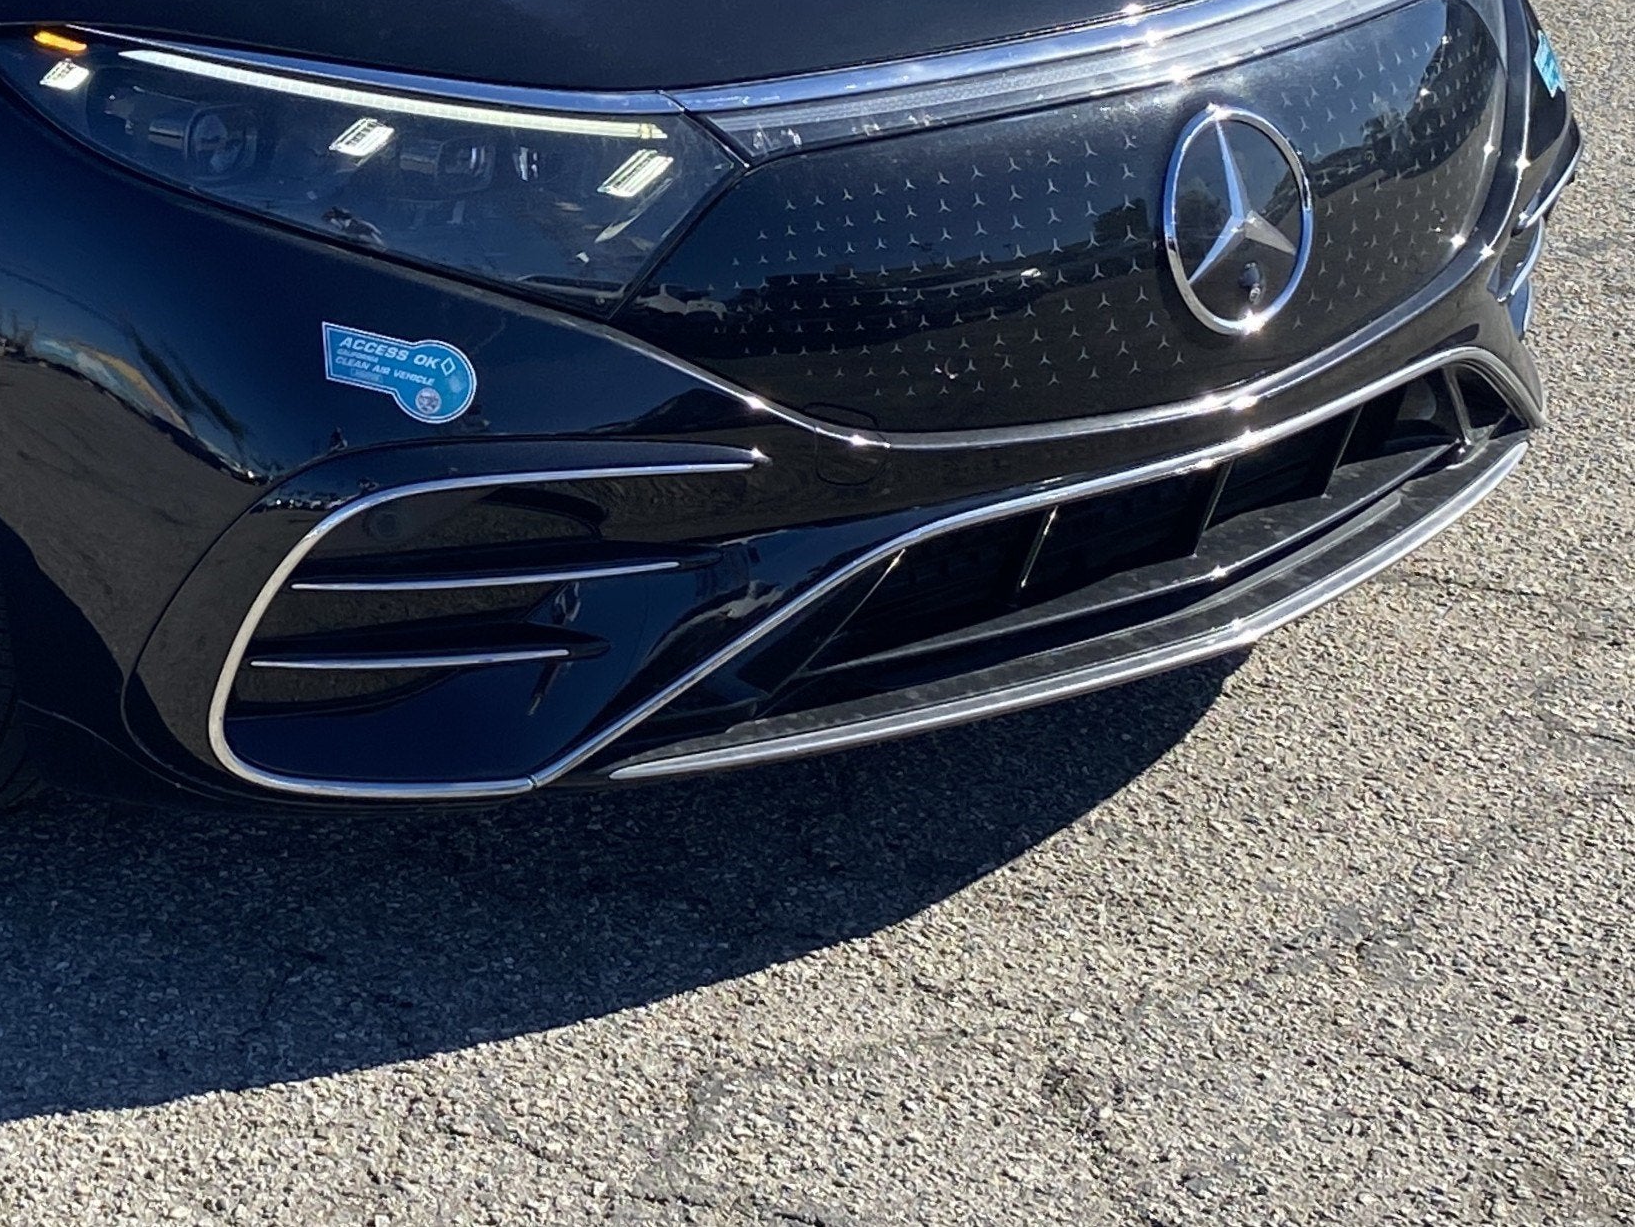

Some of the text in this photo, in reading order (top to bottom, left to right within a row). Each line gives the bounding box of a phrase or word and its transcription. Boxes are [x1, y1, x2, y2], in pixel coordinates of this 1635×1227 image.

[339, 336, 441, 370] ACCESS OK
[335, 355, 371, 370] CLEAN
[372, 364, 391, 376] AIR
[393, 368, 436, 387] VEHICLE
